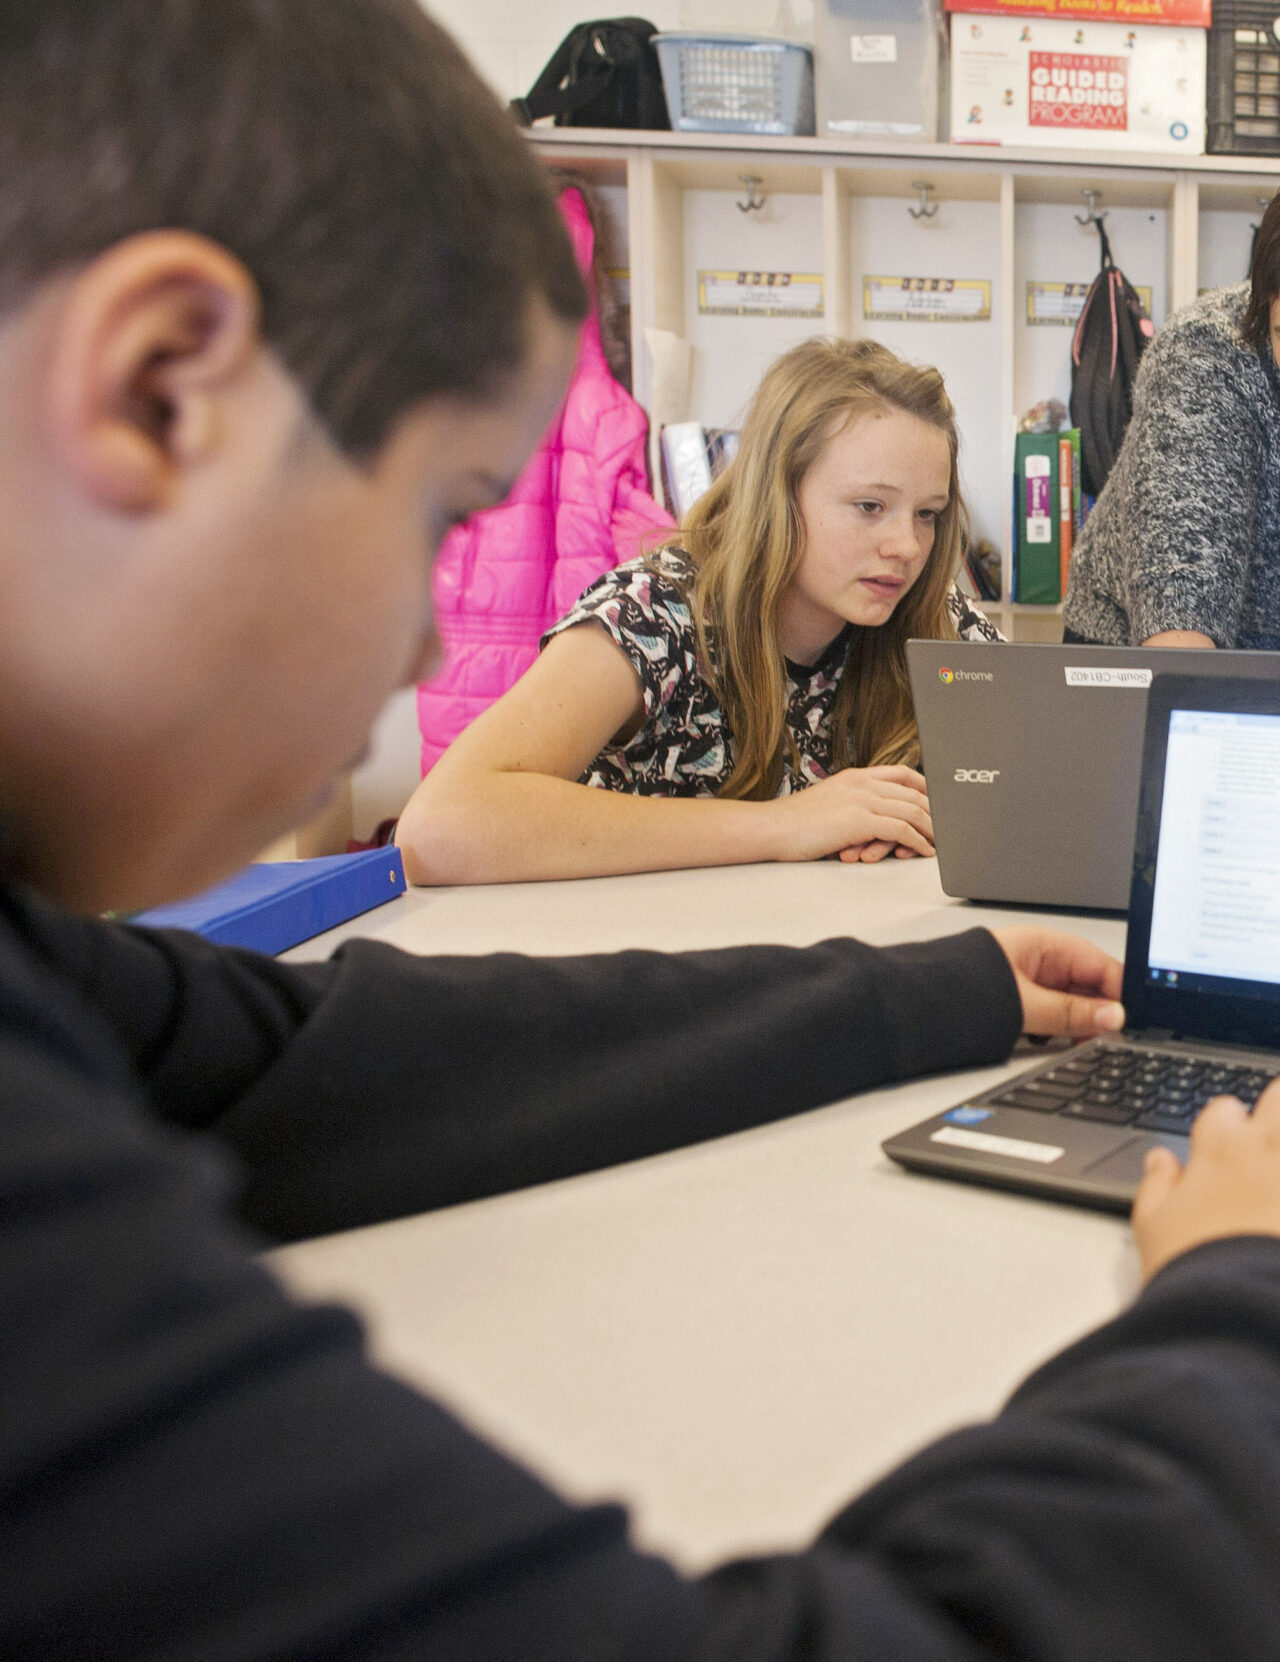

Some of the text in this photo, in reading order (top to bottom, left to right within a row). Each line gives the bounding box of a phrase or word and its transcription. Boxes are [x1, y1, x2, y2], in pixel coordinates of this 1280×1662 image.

[1032, 53, 1127, 69] SCHOLASTIC
[1032, 67, 1125, 90] GUIDED
[1032, 86, 1125, 107] READING
[1031, 104, 1126, 125] PROGRAM
[955, 670, 993, 682] chrome
[954, 768, 1000, 783] acer
